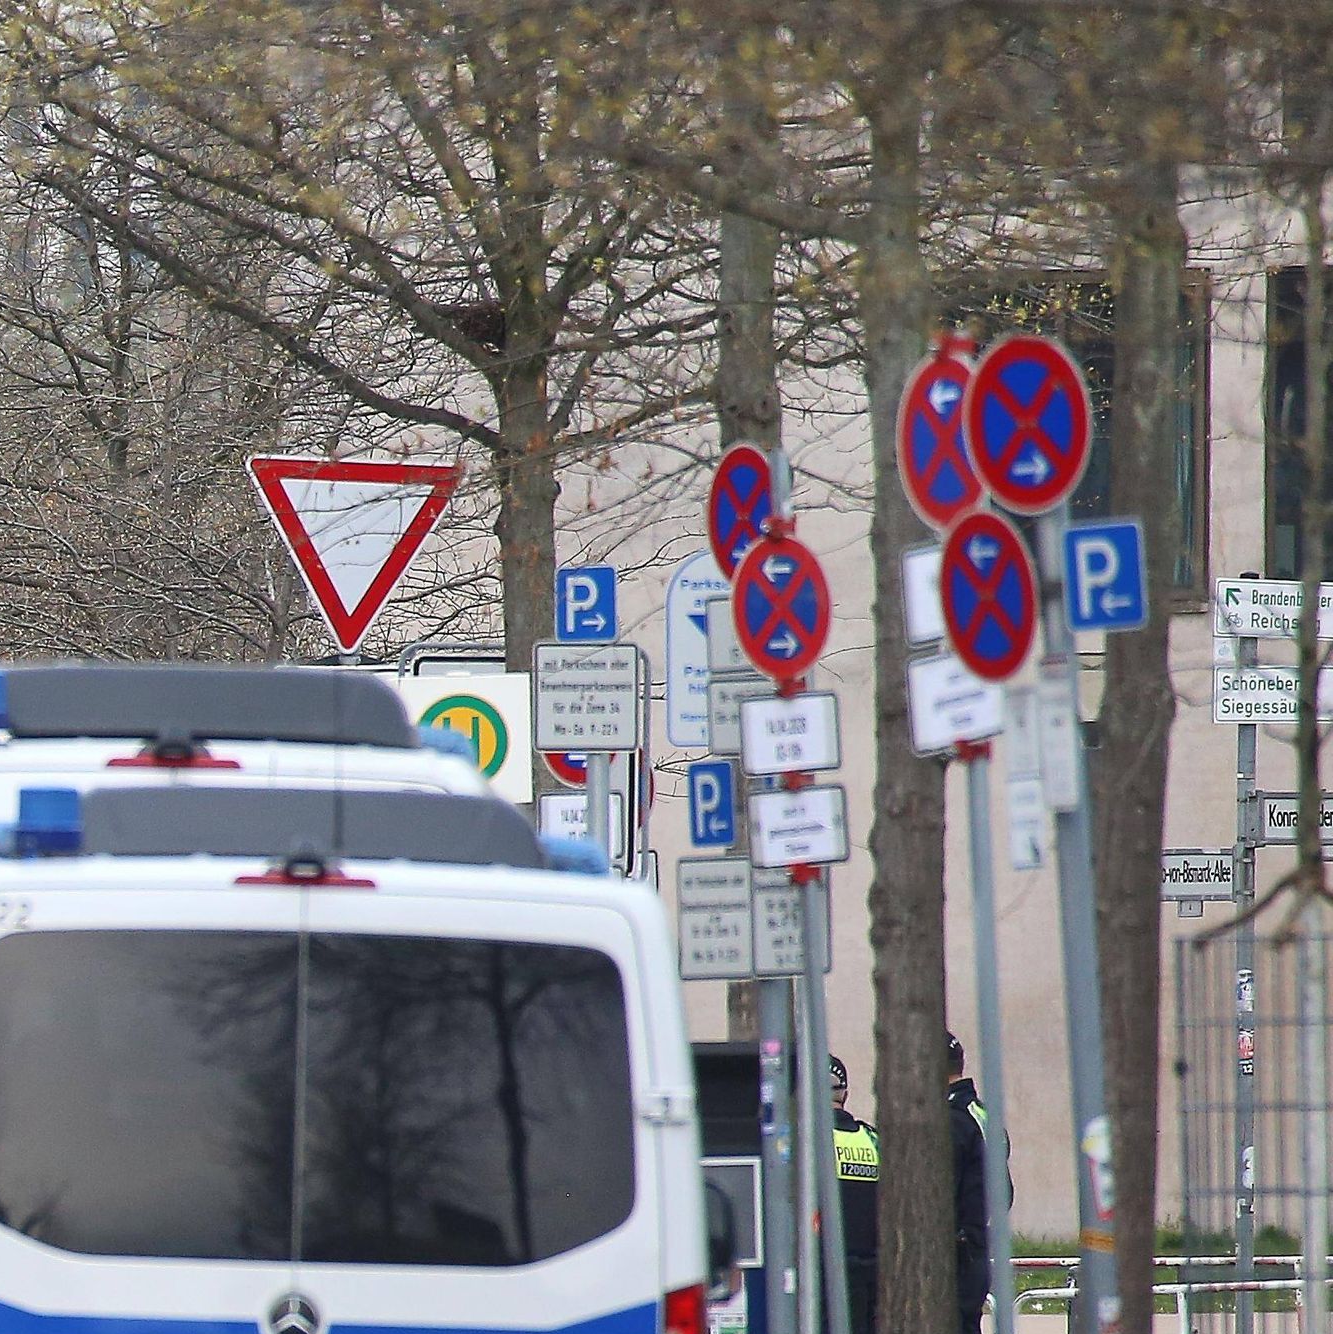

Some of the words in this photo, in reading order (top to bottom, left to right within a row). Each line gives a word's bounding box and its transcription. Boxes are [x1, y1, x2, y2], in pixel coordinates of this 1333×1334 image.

[566, 575, 597, 633] P
[1251, 589, 1332, 608] Brandenber
[1221, 675, 1300, 691] Schöneber
[1221, 698, 1298, 718] Siegessäu
[836, 1146, 875, 1163] POLIZEI
